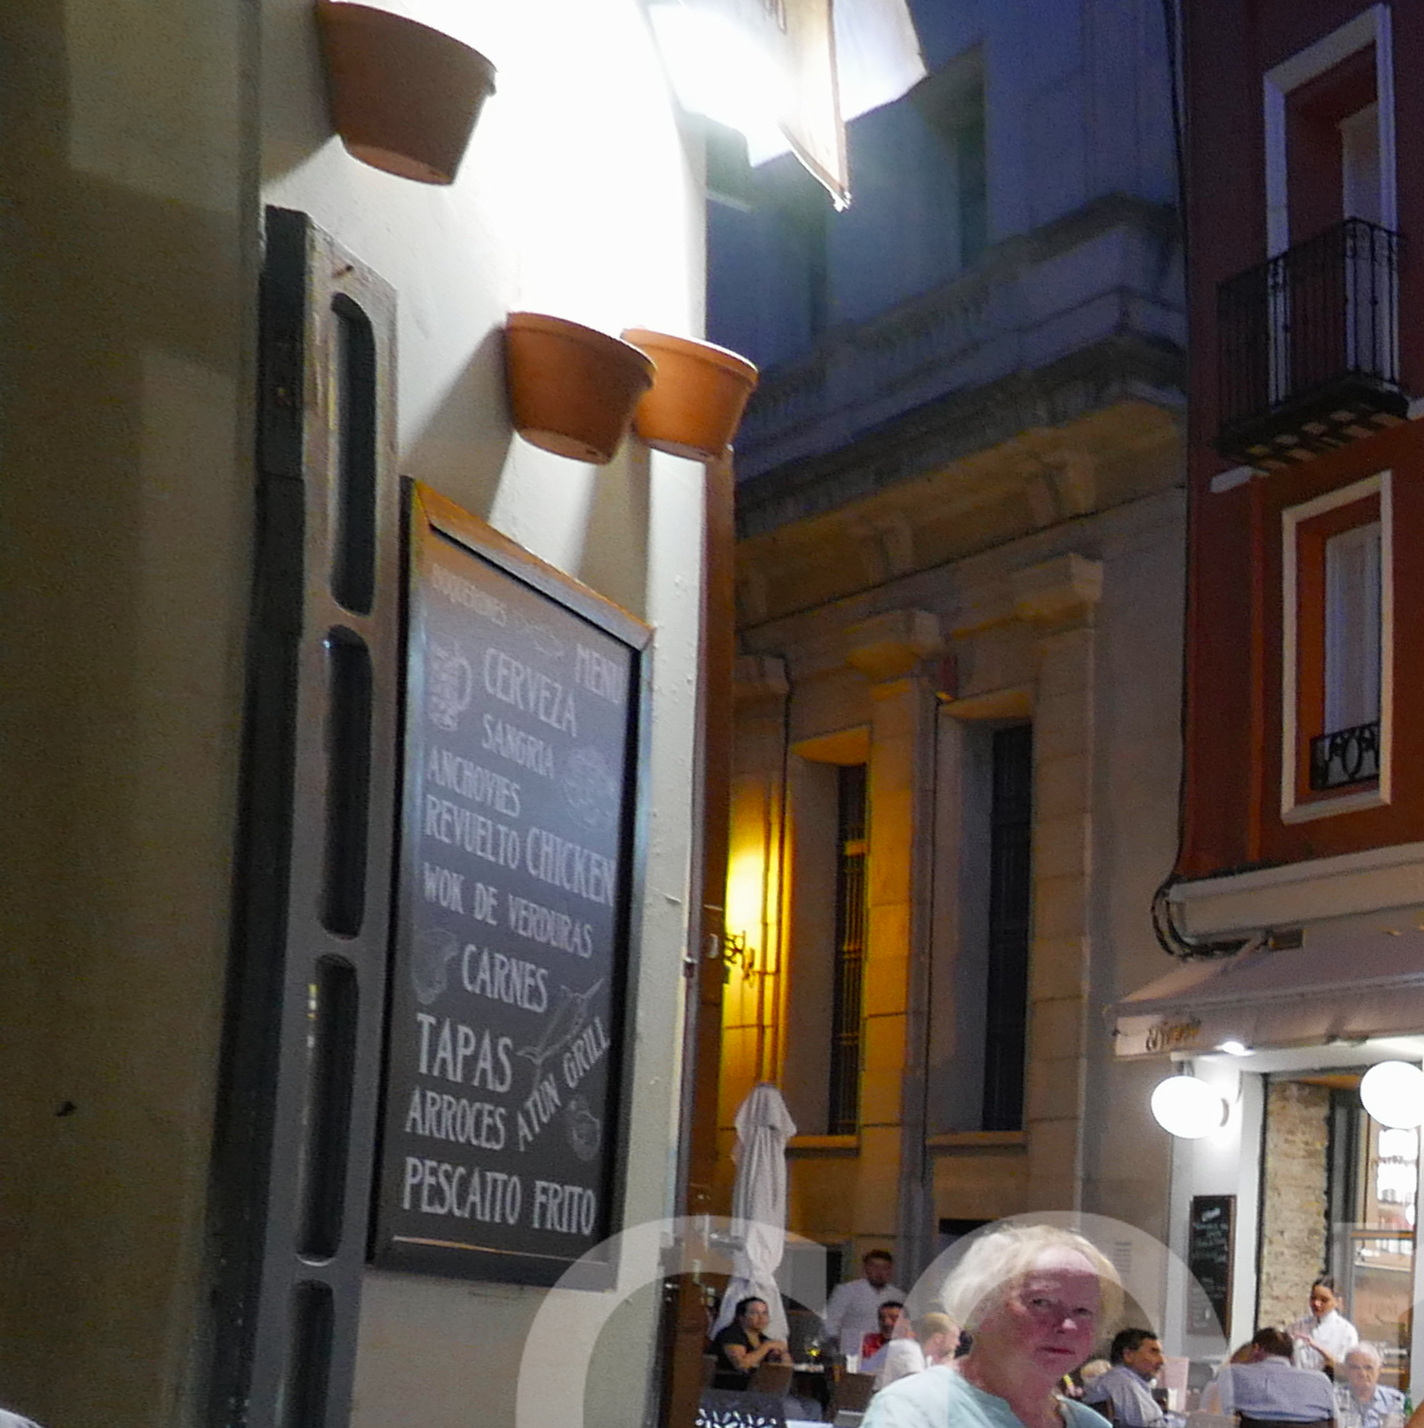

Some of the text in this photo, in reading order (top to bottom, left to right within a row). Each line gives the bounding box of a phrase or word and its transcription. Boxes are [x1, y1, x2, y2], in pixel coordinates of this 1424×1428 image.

[484, 648, 577, 738] CERVEZA
[426, 747, 521, 818] ANCHOVIES
[482, 713, 554, 778] SANGRIA
[426, 794, 616, 907] REVUELTO CHICKEN
[423, 862, 592, 959] WOK DE VERDURAS
[462, 944, 548, 1013] CARNES
[416, 1012, 513, 1093] TAPAS
[517, 1016, 611, 1152] ATUN GRILL
[405, 1084, 507, 1151] ARROCES
[403, 1157, 597, 1236] PESCAITO FRITO
